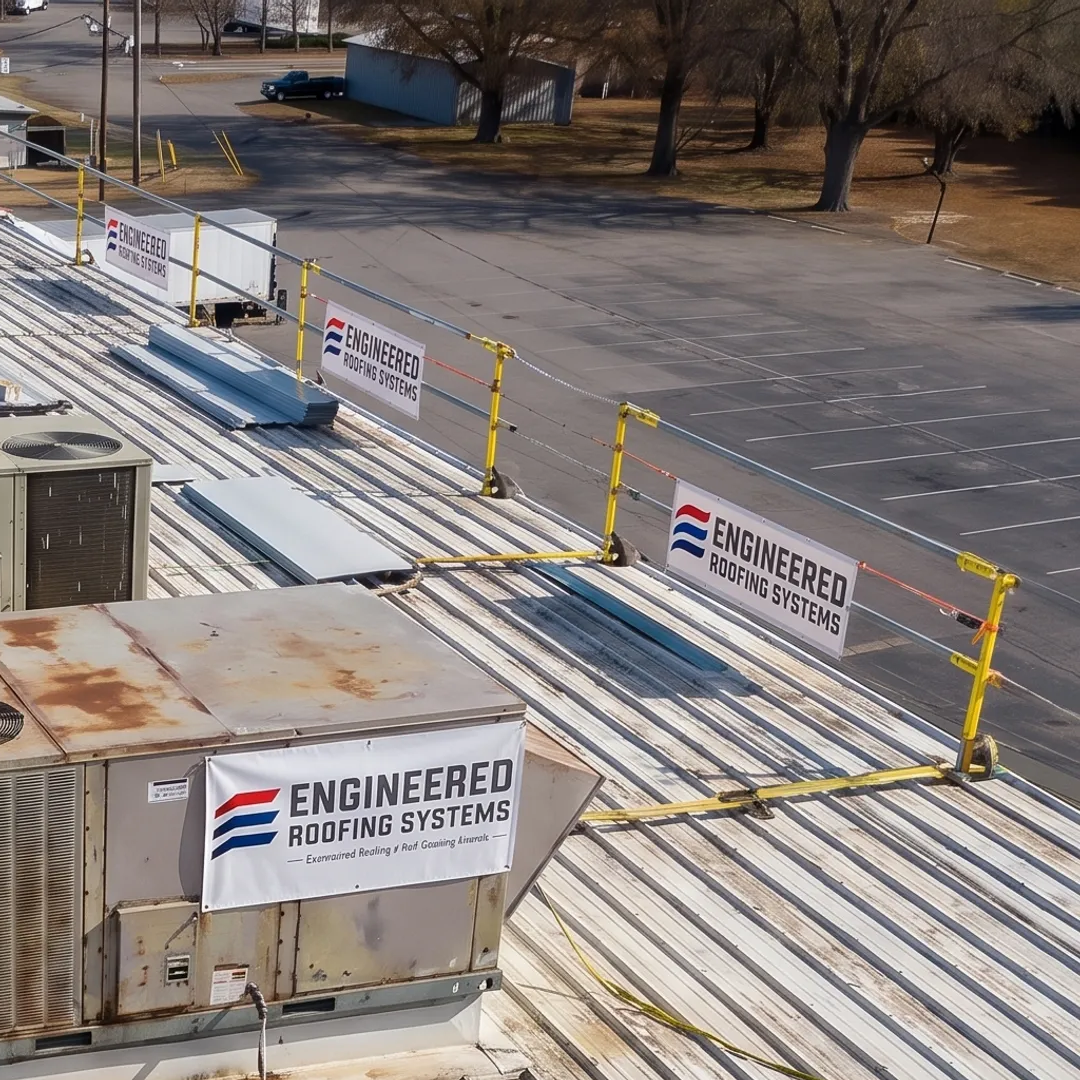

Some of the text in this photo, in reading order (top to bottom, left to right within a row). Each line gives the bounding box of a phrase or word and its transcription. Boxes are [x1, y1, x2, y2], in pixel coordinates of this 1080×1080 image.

[119, 222, 166, 260] ENGINEERED
[343, 352, 418, 402] ROOFING SYSTEMS
[345, 324, 420, 381] ENGINEERED
[712, 516, 848, 608] ENGINEERED
[709, 551, 841, 636] ROOFING SYSTEMS
[289, 758, 514, 818] ENGINEERED
[288, 799, 510, 847] ROOFING SYSTEMS
